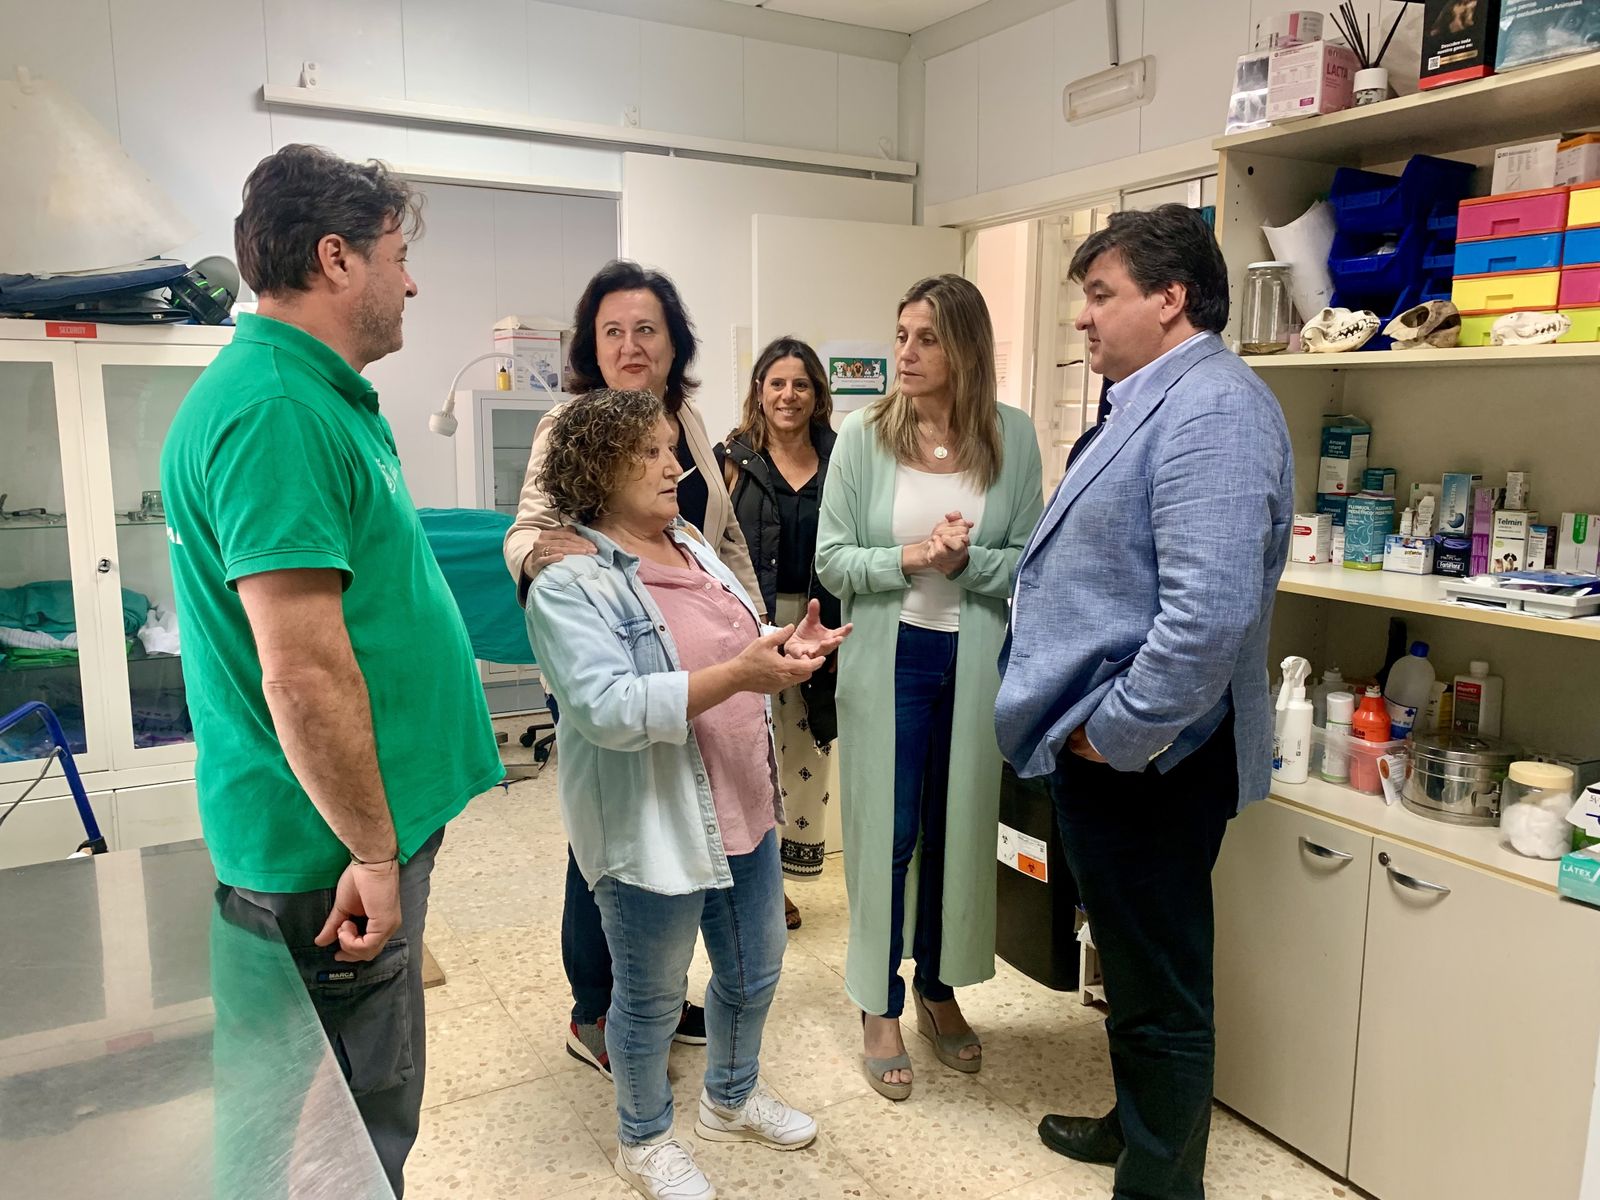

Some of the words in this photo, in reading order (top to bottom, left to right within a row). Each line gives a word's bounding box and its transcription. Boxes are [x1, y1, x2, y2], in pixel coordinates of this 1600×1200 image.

[1553, 1, 1583, 9] Animales
[1441, 41, 1460, 49] Descubre
[1497, 518, 1522, 526] Telmin
[1440, 560, 1461, 570] FortiFlora
